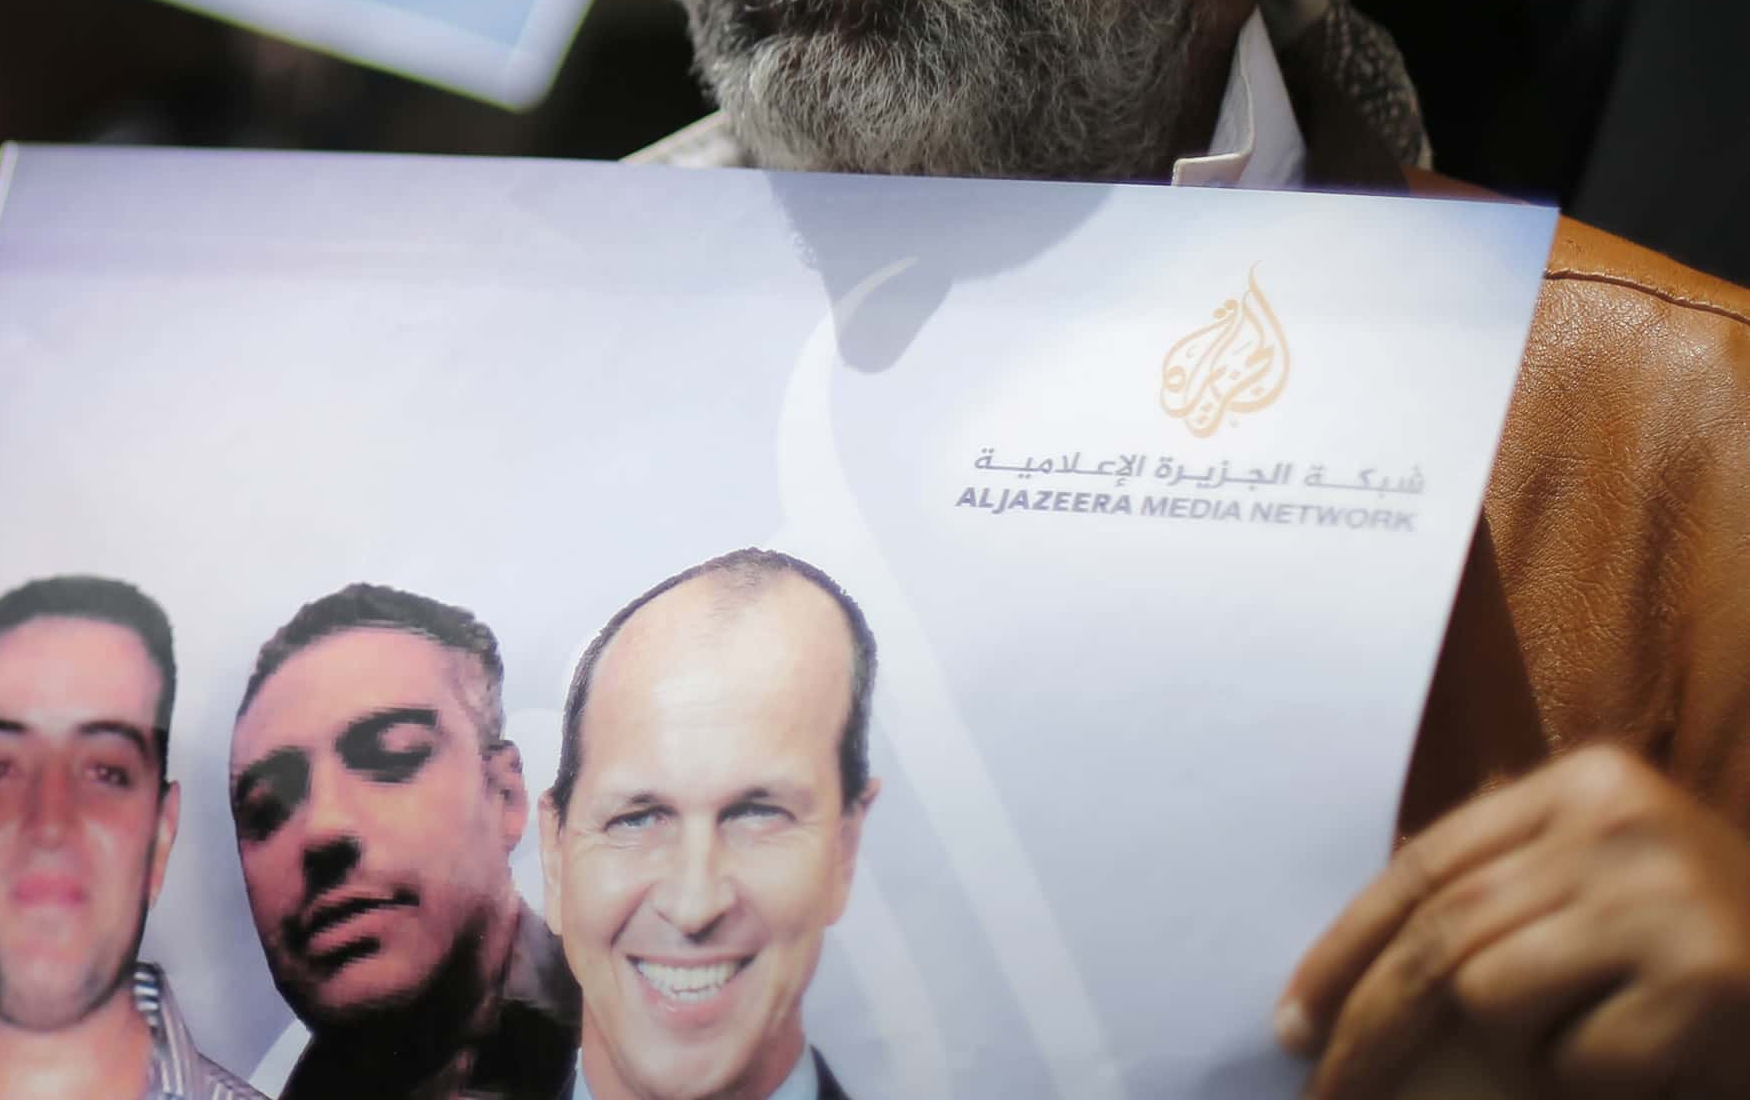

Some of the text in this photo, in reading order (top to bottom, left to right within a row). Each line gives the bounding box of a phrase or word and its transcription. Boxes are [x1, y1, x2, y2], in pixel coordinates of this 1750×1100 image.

[973, 446, 1426, 501] شبكة الجزيرة الإعلامية
[955, 486, 1419, 534] ALJAZEERA MEDIA NETWORK
